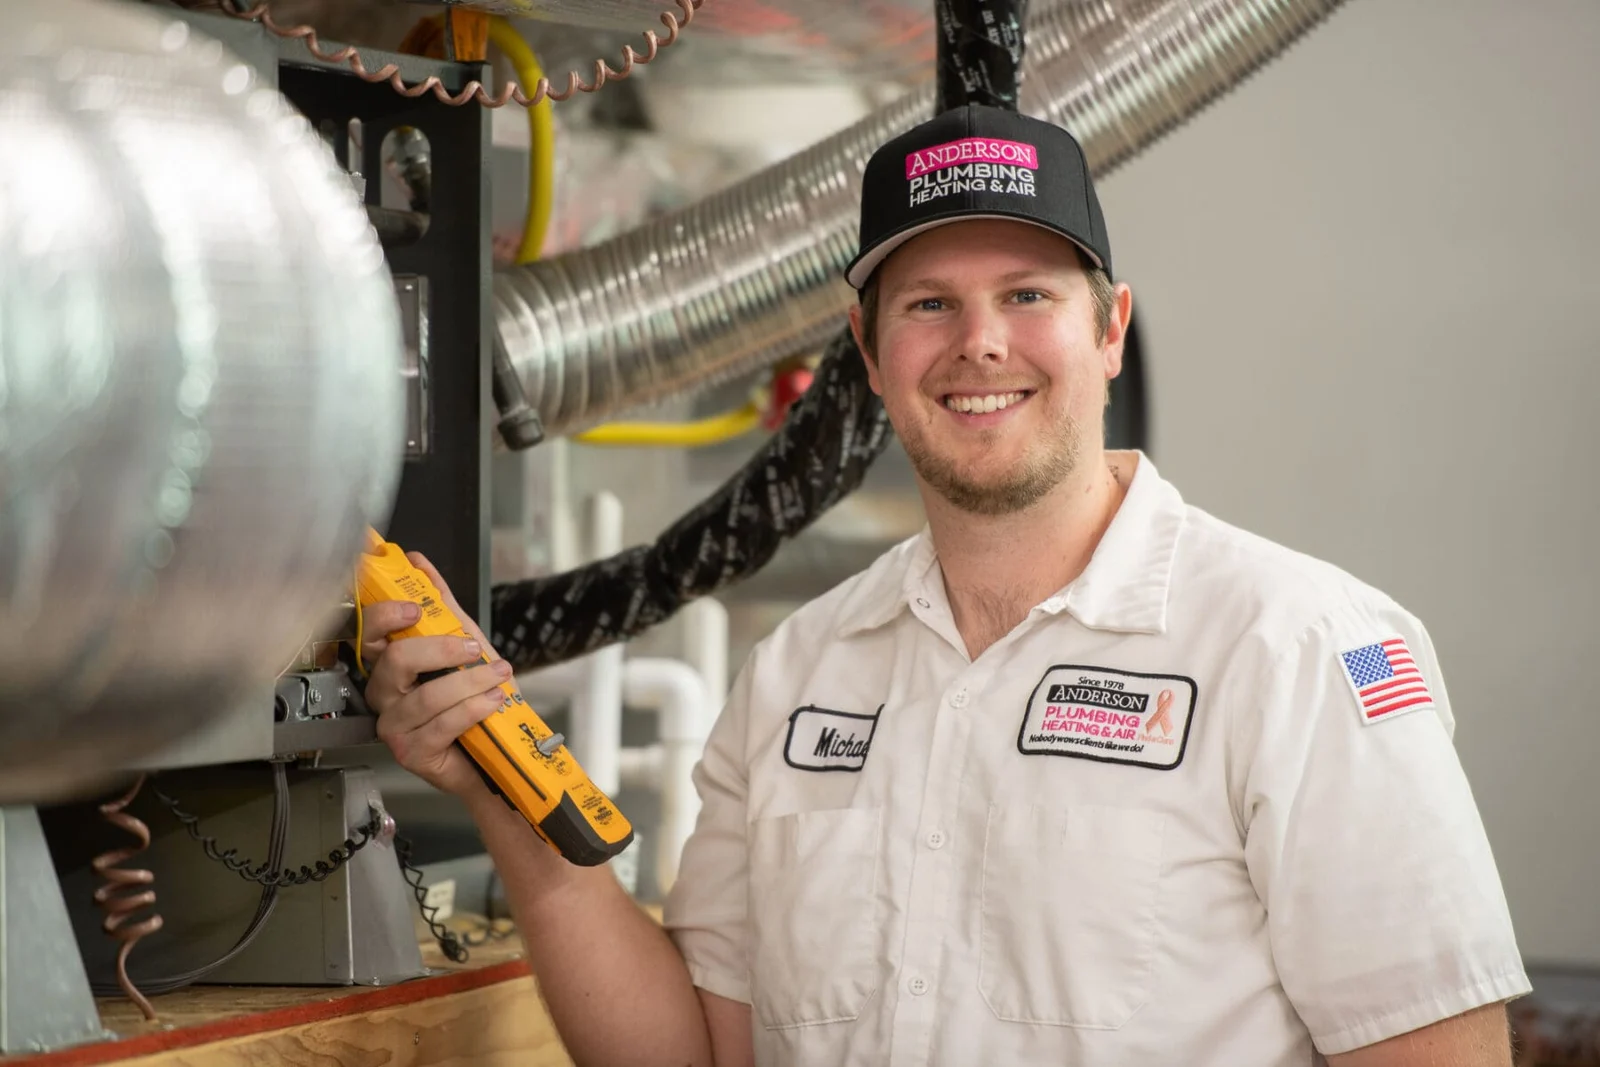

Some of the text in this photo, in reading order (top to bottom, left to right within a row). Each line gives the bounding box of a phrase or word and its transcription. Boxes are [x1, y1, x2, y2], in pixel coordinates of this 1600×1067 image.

[909, 141, 1031, 176] ANDERSON
[909, 164, 1035, 194] PLUMBING
[909, 179, 1037, 208] HEATING & AIR
[1078, 676, 1125, 691] Since 1978
[1052, 685, 1146, 711] ANDERSON
[1045, 705, 1141, 728] PLUMBING
[813, 727, 870, 758] Michae
[1041, 720, 1099, 736] HEATING
[1100, 726, 1111, 738] &
[1112, 727, 1136, 741] AIR
